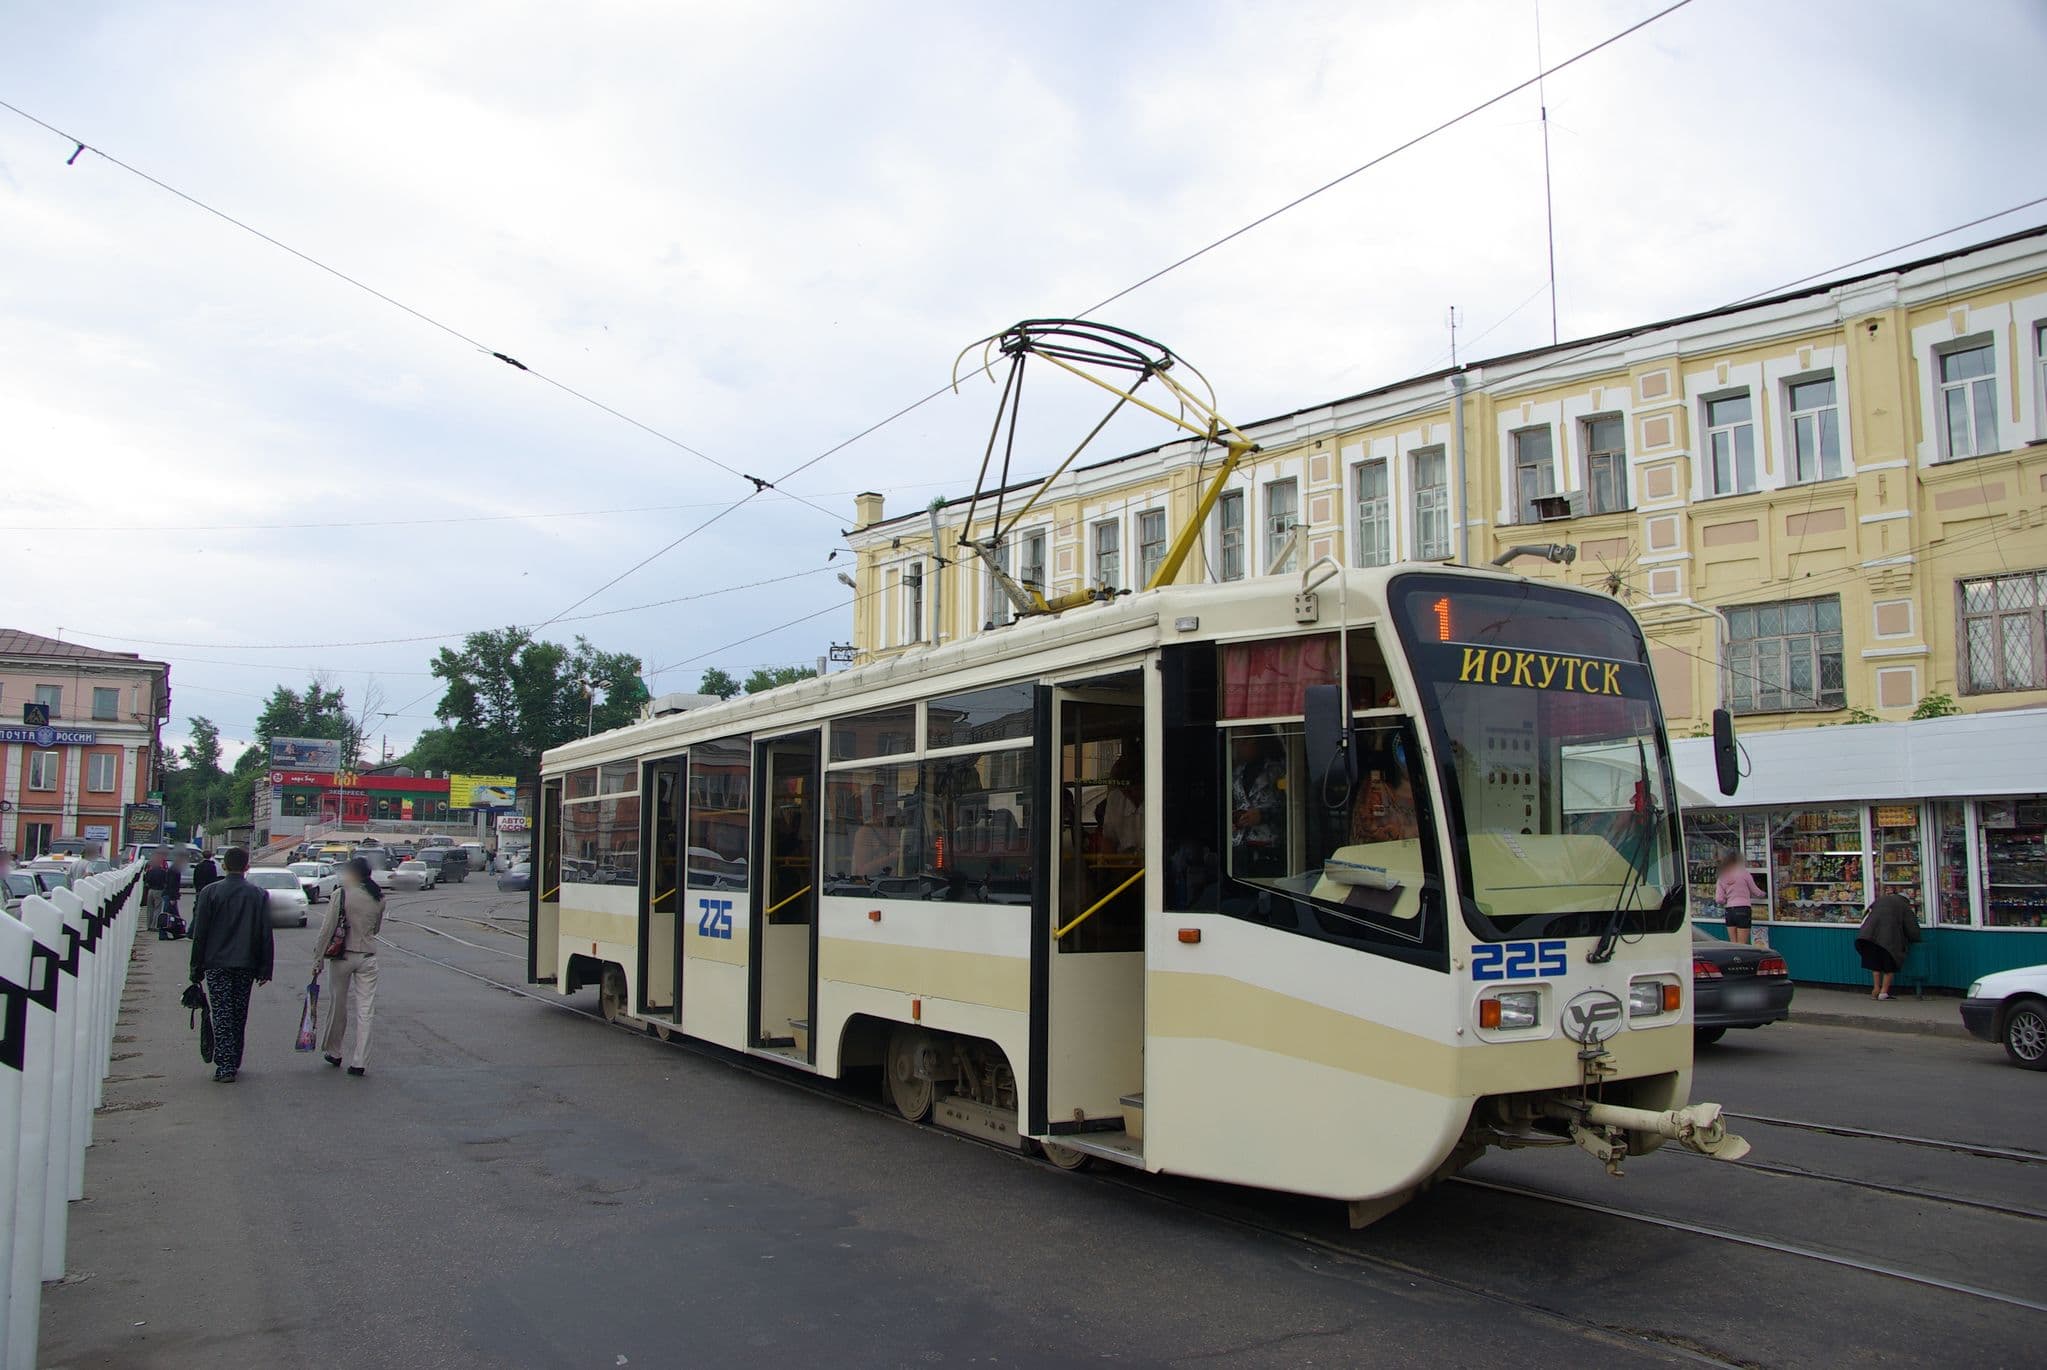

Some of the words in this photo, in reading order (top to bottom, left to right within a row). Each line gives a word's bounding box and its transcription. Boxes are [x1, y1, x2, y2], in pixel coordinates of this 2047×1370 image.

[1432, 597, 1450, 641] 1
[1459, 648, 1622, 696] ИРКУТСК
[56, 732, 92, 742] РОССИИ
[699, 898, 732, 939] 225
[1471, 941, 1567, 981] 225
